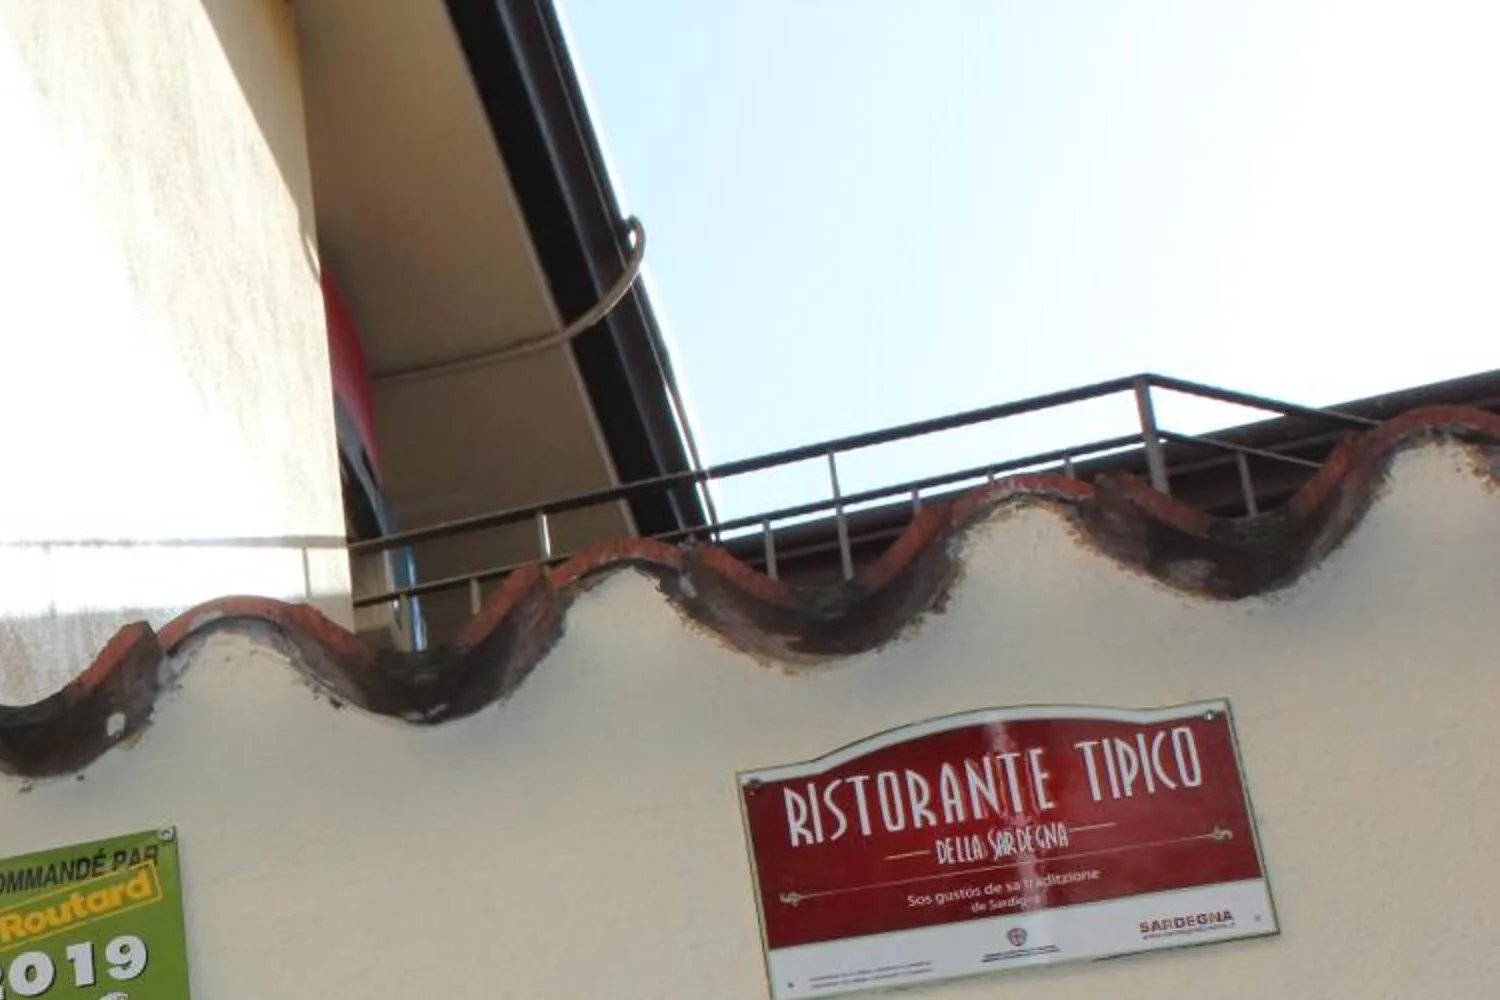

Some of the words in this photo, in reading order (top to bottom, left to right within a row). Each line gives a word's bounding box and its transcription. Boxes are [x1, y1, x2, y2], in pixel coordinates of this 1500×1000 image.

[783, 751, 1055, 847] RISTORANTE
[1073, 726, 1202, 802] TIPICO
[935, 835, 985, 865] DELLA
[987, 822, 1070, 862] SARDEGNA
[112, 845, 159, 871] PAR
[907, 893, 933, 907] Sos
[934, 886, 982, 906] gustos
[983, 881, 1002, 895] de
[1005, 880, 1021, 892] sa
[1139, 909, 1234, 933] SARDEGNA
